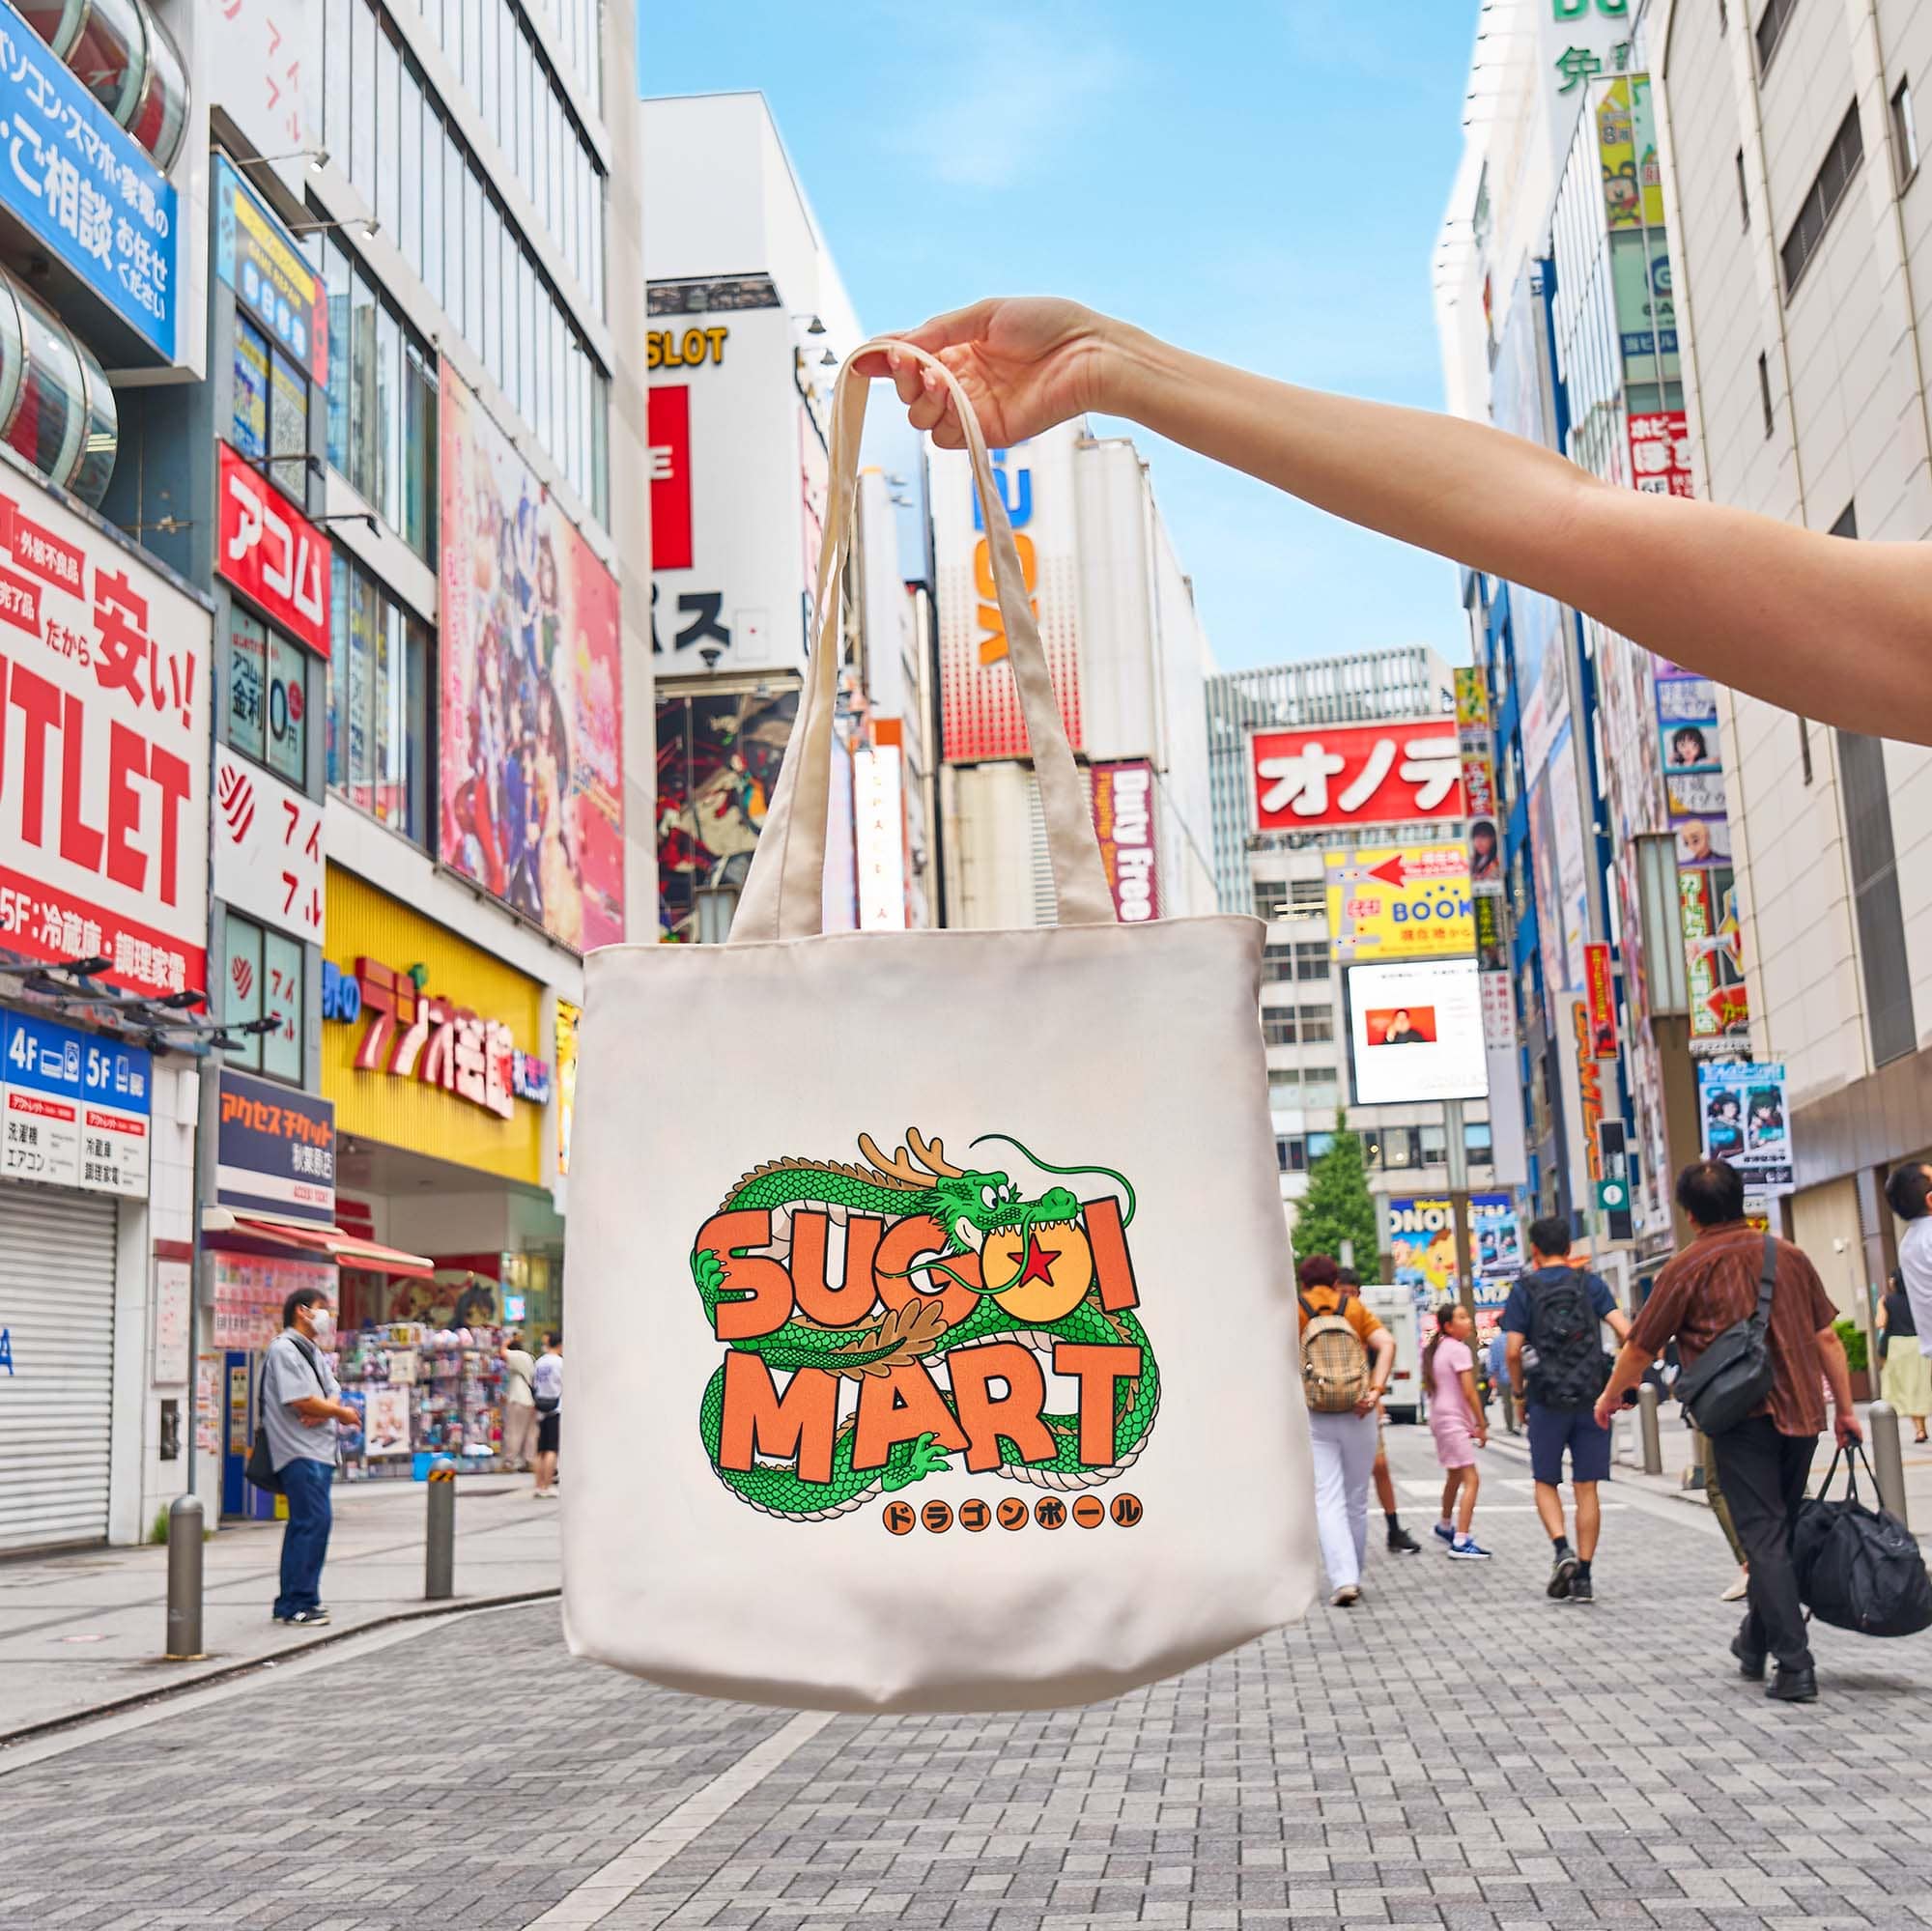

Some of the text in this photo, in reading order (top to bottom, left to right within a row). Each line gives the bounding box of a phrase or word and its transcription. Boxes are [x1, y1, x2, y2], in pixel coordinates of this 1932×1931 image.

[645, 327, 727, 370] SLOT
[229, 474, 325, 627] アコム
[46, 617, 91, 667] だから
[10, 1027, 38, 1071] 4F
[86, 1047, 110, 1089] 5F
[221, 1093, 333, 1148] アクセスチケット
[8, 1150, 44, 1172] エアコン
[694, 1195, 1141, 1342] SUGOI
[718, 1341, 1144, 1485] MART
[883, 1492, 1143, 1536] ドラゴンボール
